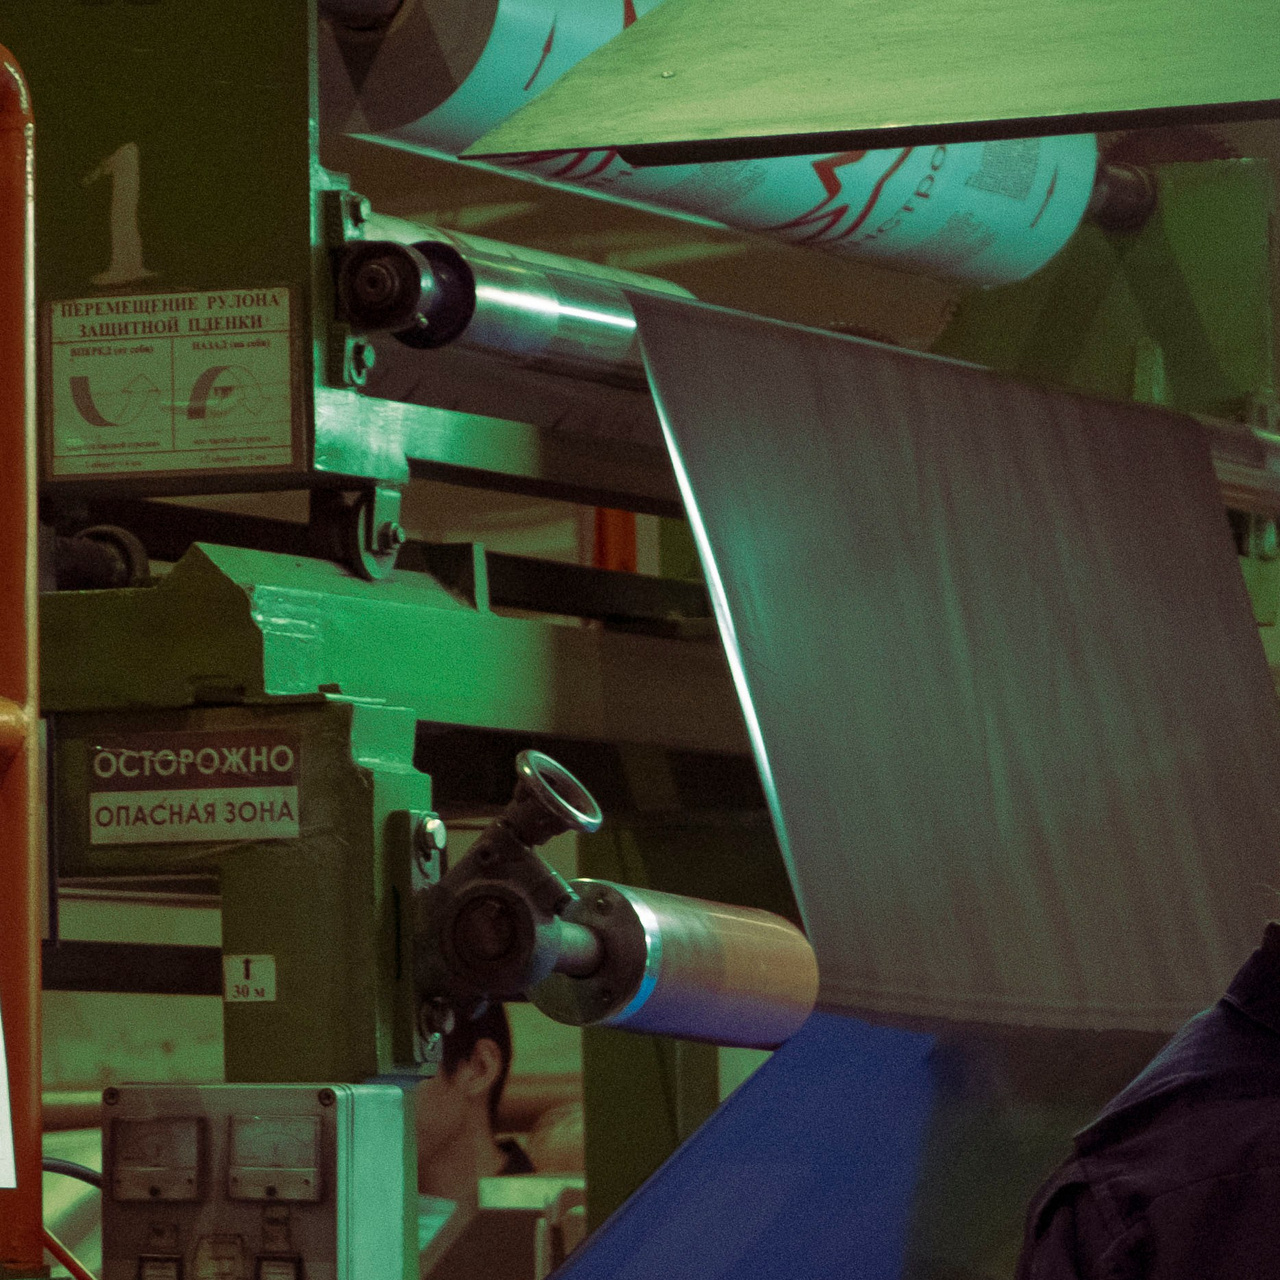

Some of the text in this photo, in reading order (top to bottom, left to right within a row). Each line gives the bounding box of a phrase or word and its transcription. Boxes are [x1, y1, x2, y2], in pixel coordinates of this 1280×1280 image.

[83, 142, 157, 284] 1
[61, 293, 281, 318] ПЕРЕМЕЩЕНИЕ РУЛОНА
[79, 314, 263, 338] ЗАЩИТНОЙ ПЛЕНКИ
[93, 744, 296, 779] ОСТОРОЖНО
[94, 800, 295, 827] ОПАСНАЯ ЗОНА
